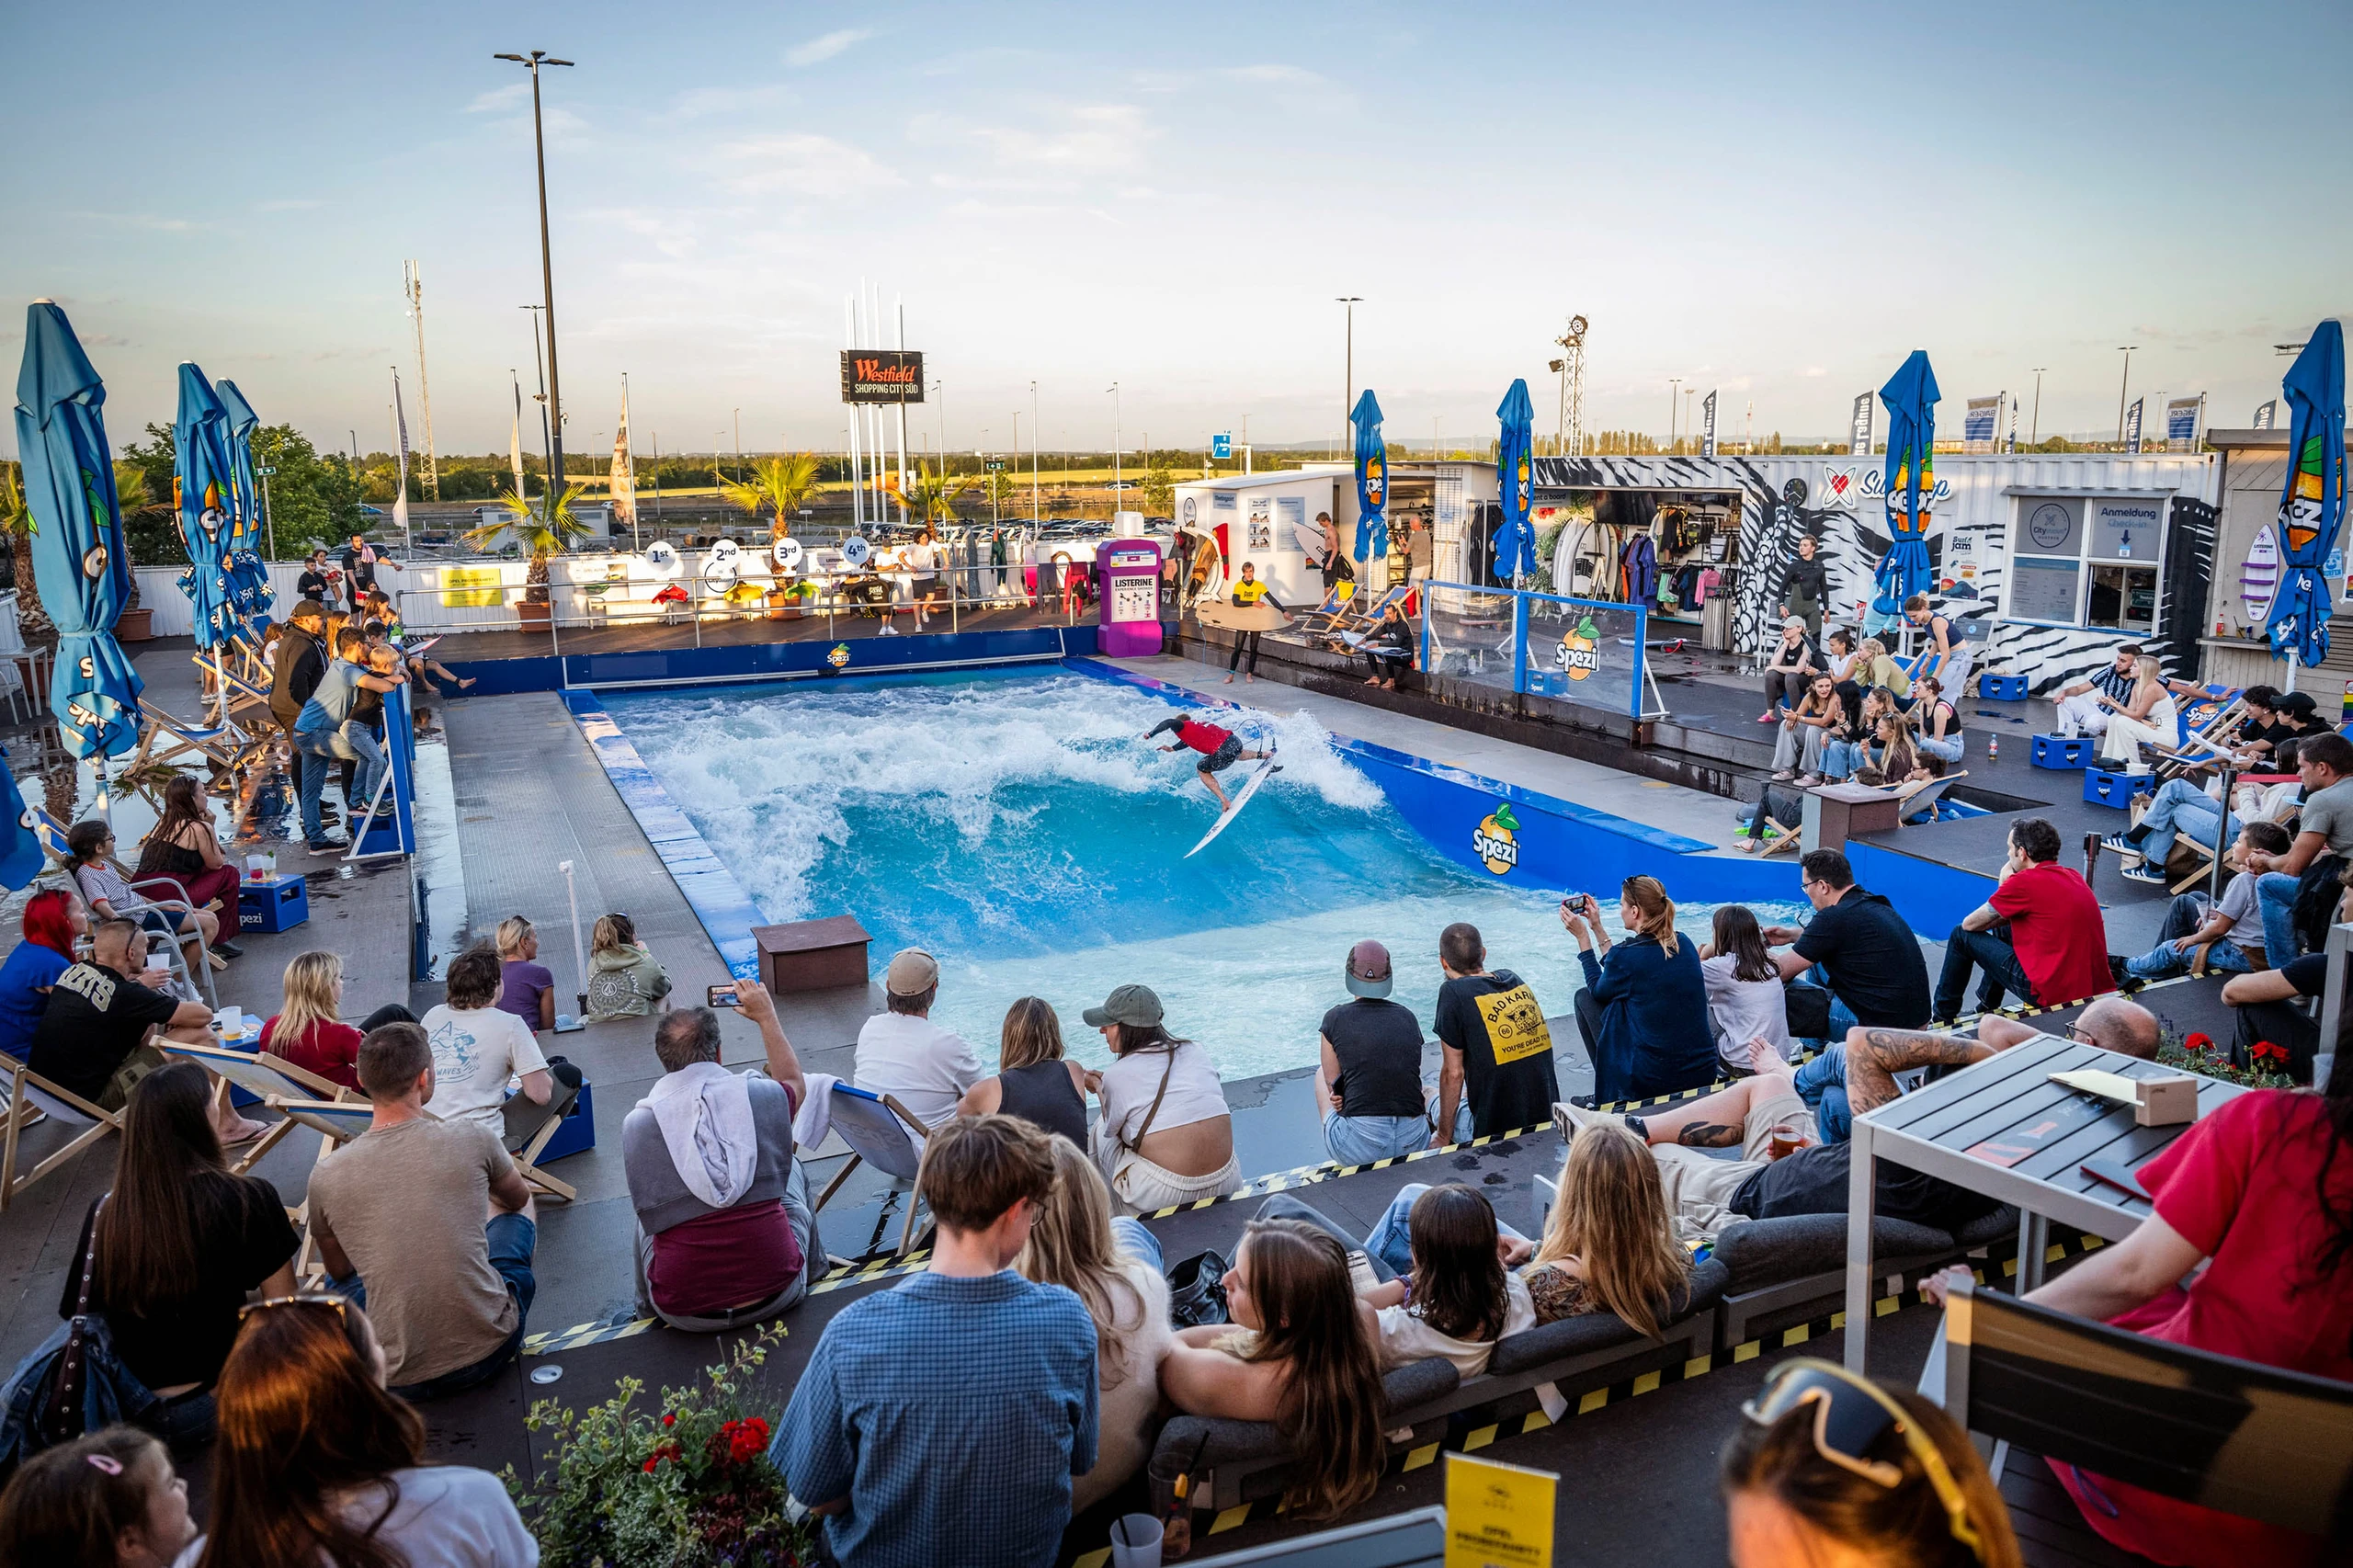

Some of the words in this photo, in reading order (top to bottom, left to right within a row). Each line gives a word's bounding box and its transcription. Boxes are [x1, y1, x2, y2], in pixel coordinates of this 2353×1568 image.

[854, 358, 917, 382] Westfield
[855, 384, 888, 393] SHOPPING
[889, 384, 904, 393] CITY
[2101, 507, 2156, 519] Anmeldung
[2108, 518, 2147, 528] Check-in
[780, 546, 797, 559] 3rd
[847, 544, 866, 557] 4th
[1951, 542, 1971, 551] jam
[653, 550, 669, 562] 1st
[717, 548, 736, 561] 2nd
[1115, 578, 1153, 587] LISTERINE
[827, 653, 849, 665] Spezi
[1555, 642, 1597, 674] Spezi
[1472, 828, 1518, 867] Spezi
[239, 913, 263, 926] pezi
[1487, 1000, 1506, 1023] BAD
[1502, 1042, 1525, 1053] YOU'RE
[1526, 1037, 1540, 1047] DEAD
